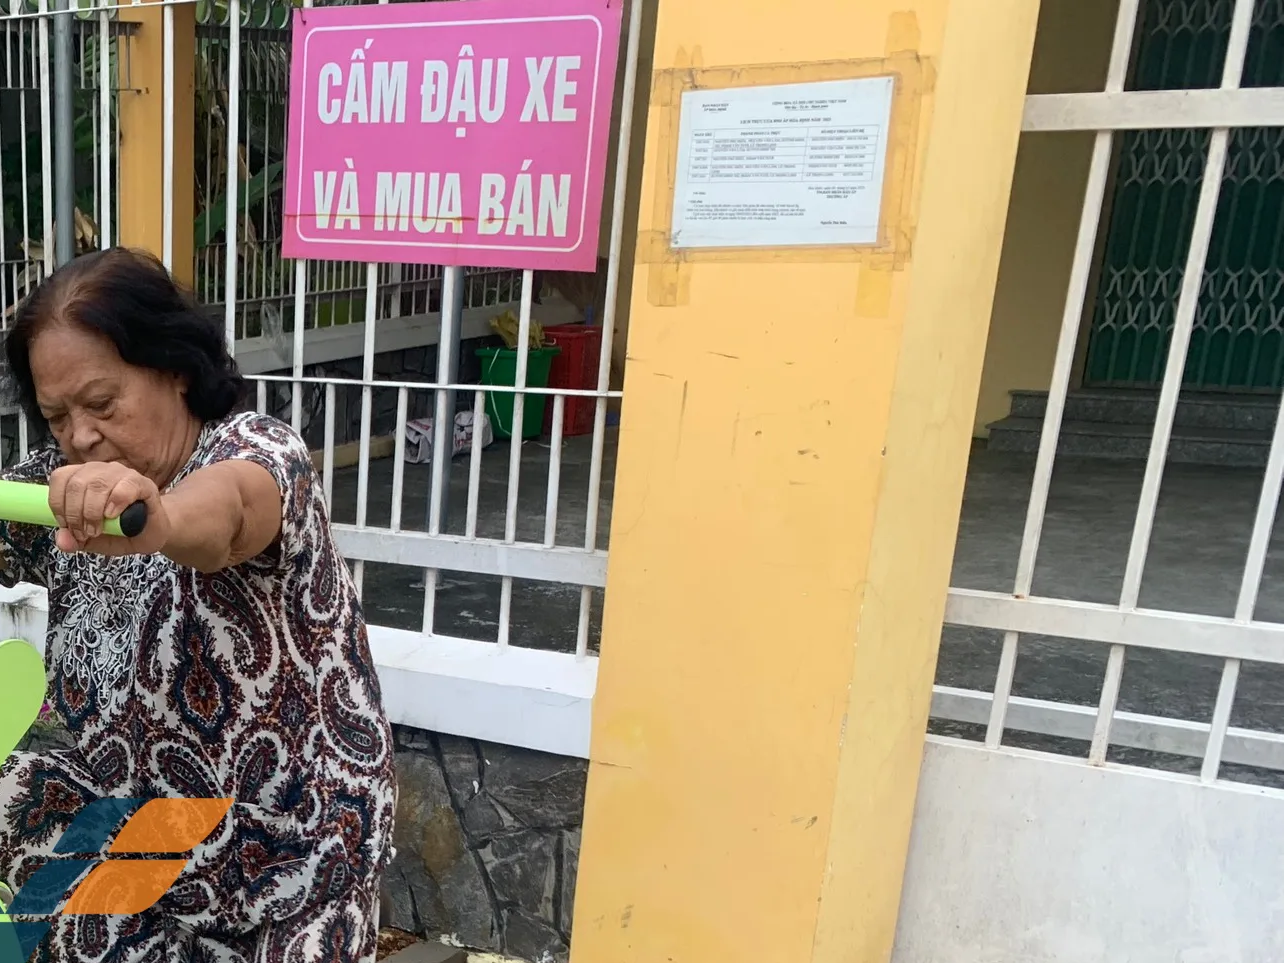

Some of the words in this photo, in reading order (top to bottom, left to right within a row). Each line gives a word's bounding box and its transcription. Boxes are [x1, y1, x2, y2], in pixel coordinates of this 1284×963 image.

[317, 39, 408, 124] CẤM
[420, 45, 508, 137] ĐẬU
[520, 56, 581, 122] XE
[314, 158, 361, 230] VÀ
[374, 171, 463, 234] MUA
[477, 159, 571, 237] BÁN
